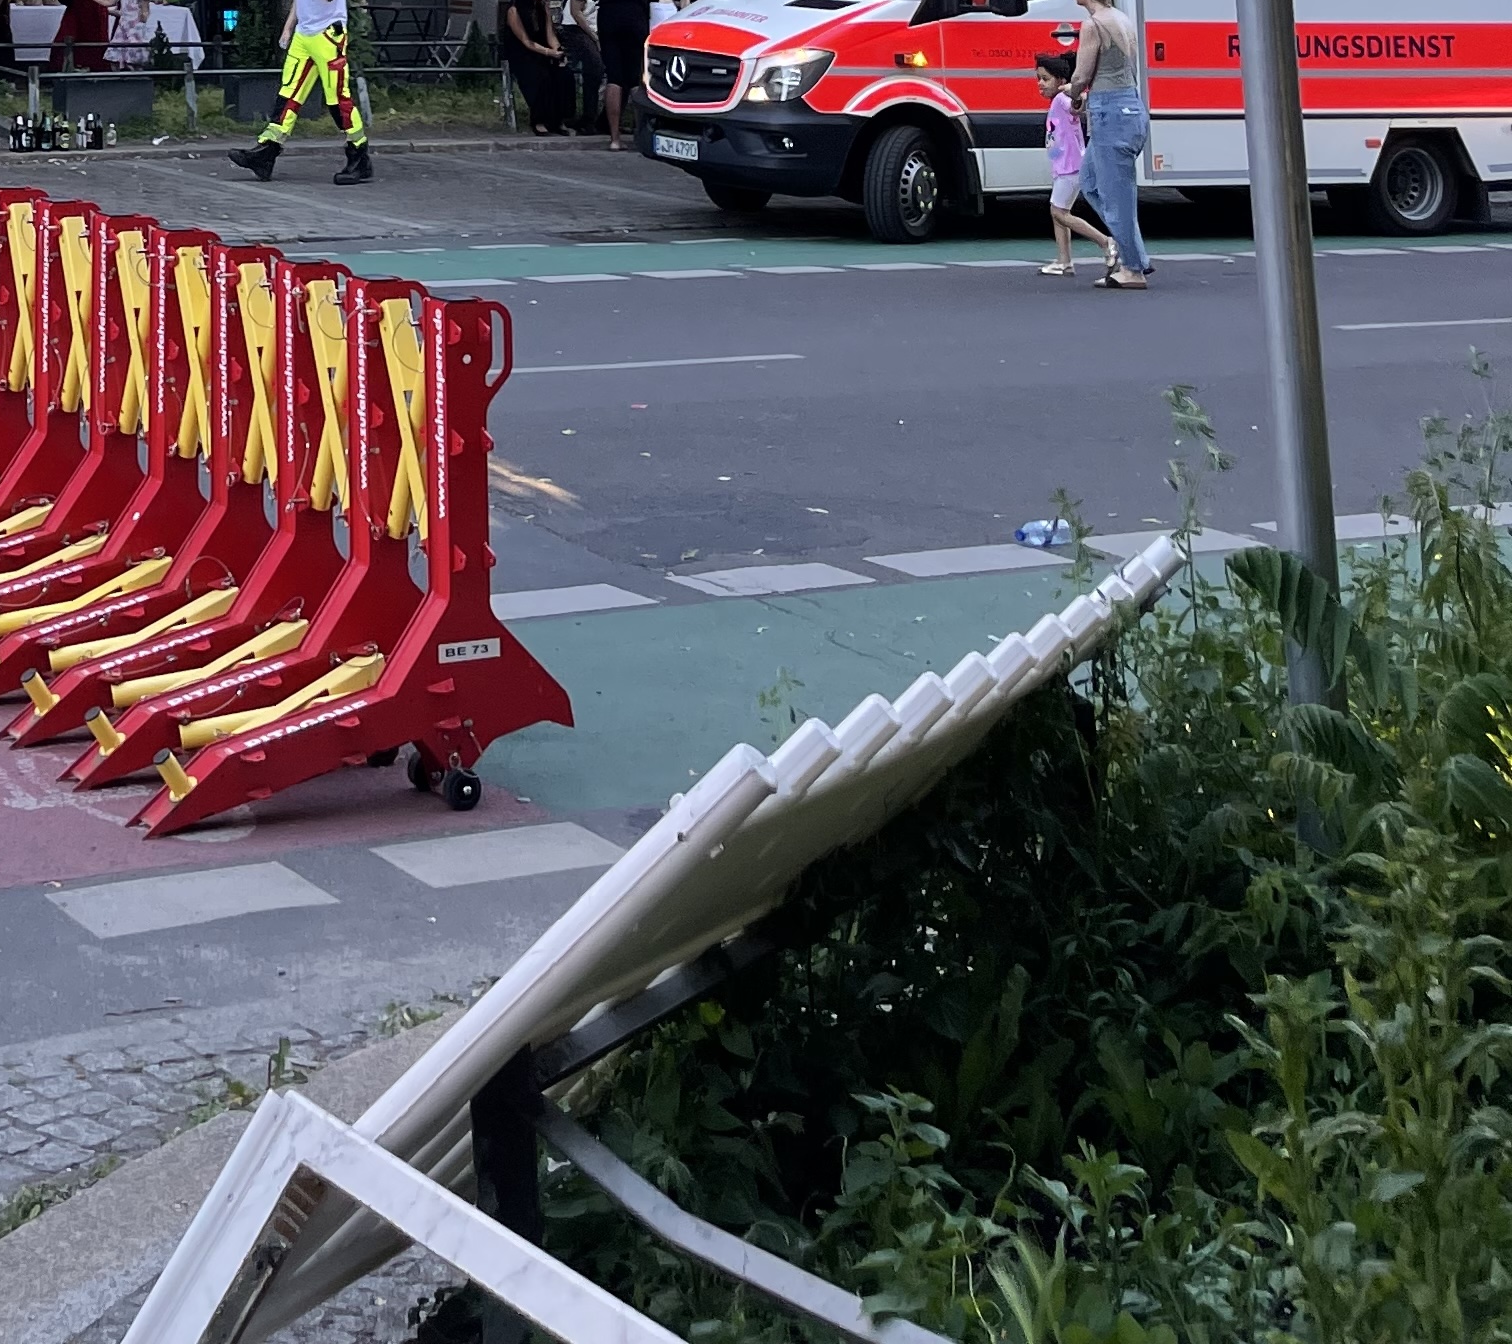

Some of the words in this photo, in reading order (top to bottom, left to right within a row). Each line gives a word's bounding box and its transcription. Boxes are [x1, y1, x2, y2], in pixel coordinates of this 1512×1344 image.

[1228, 34, 1456, 59] RUNGSDIENST
[156, 236, 166, 414] www.zufahrtssperrede
[217, 252, 228, 438] www.zufahrtssperrede
[356, 287, 367, 490] www.zufahrtssperrede
[432, 308, 446, 519] www.zufahrtssperre.de
[445, 645, 467, 658] BE
[471, 644, 489, 655] 73
